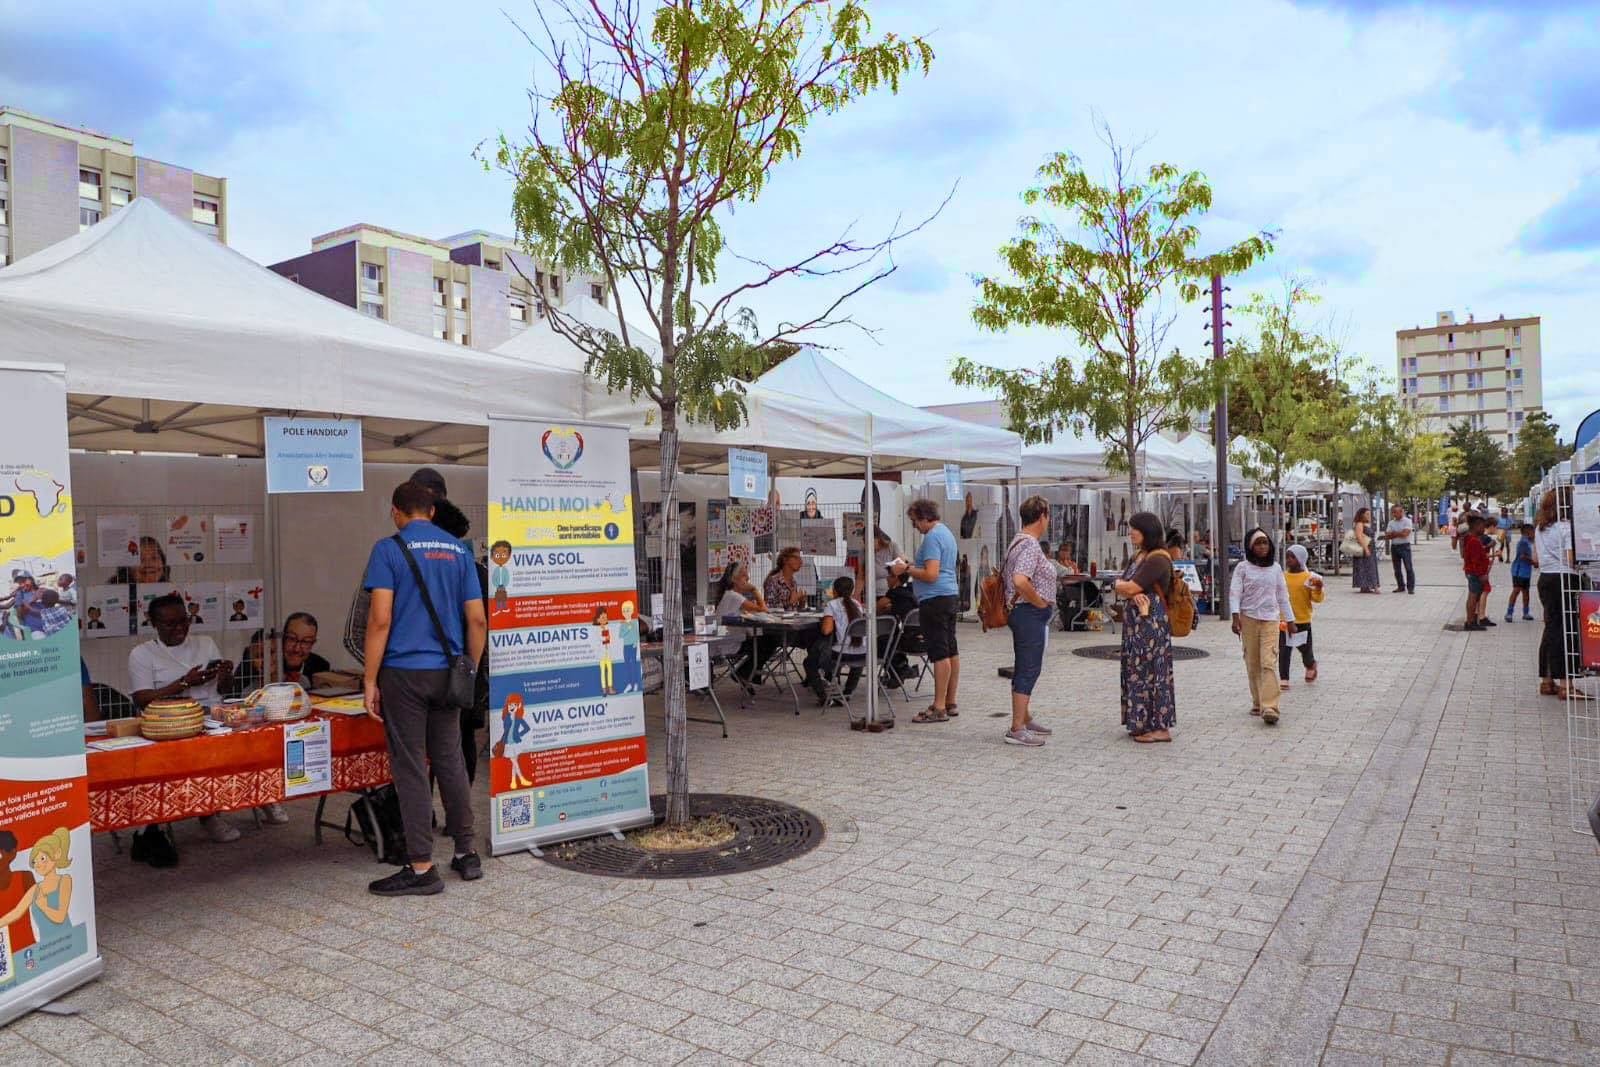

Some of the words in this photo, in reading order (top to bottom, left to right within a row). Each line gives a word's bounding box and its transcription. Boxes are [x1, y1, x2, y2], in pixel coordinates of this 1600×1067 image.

[283, 427, 305, 436] POLE
[306, 428, 348, 437] HANDICAP
[502, 496, 555, 513] HANDI
[559, 497, 590, 513] MOI
[570, 524, 602, 533] handicaps
[513, 553, 545, 567] VIVA
[548, 552, 585, 566] SCOL
[491, 633, 523, 648] VIVA
[526, 627, 589, 645] AIDANTS
[8, 658, 43, 668] formation
[44, 655, 61, 664] pour
[0, 671, 11, 679] de
[13, 666, 49, 678] handicap
[532, 709, 564, 724] VIVA
[567, 703, 608, 719] CIVIQ'
[7, 796, 21, 804] fois
[23, 792, 39, 802] plus
[39, 782, 73, 796] exposées
[5, 802, 35, 815] fondées
[36, 798, 49, 806] sur
[14, 809, 41, 821] valides
[41, 801, 68, 816] (source
